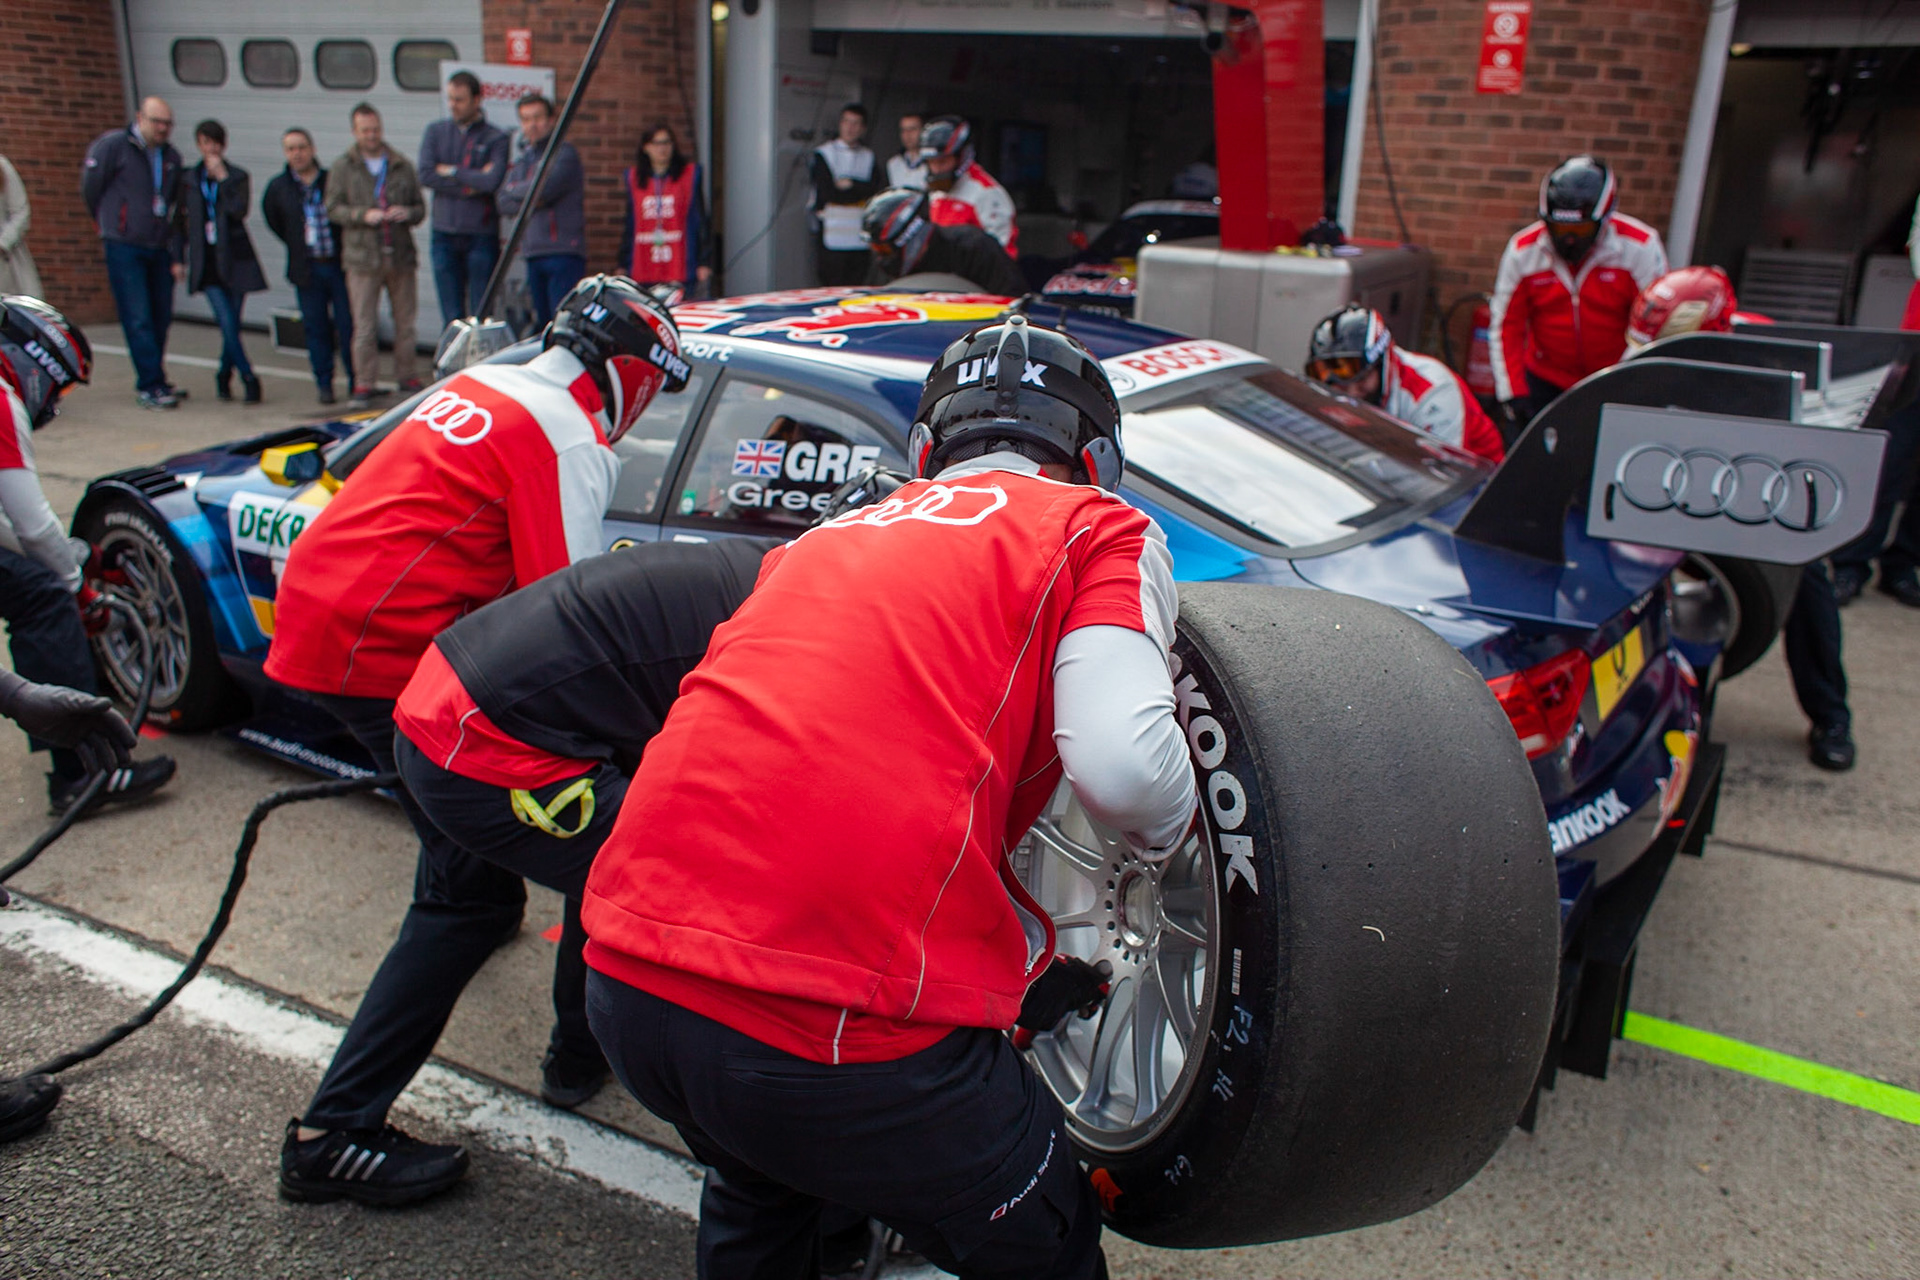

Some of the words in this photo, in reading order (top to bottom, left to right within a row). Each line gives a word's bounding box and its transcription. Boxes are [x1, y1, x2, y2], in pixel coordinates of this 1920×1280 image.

[650, 342, 690, 382] uvex
[957, 358, 1048, 388] uvx
[1009, 1174, 1039, 1209] Audi
